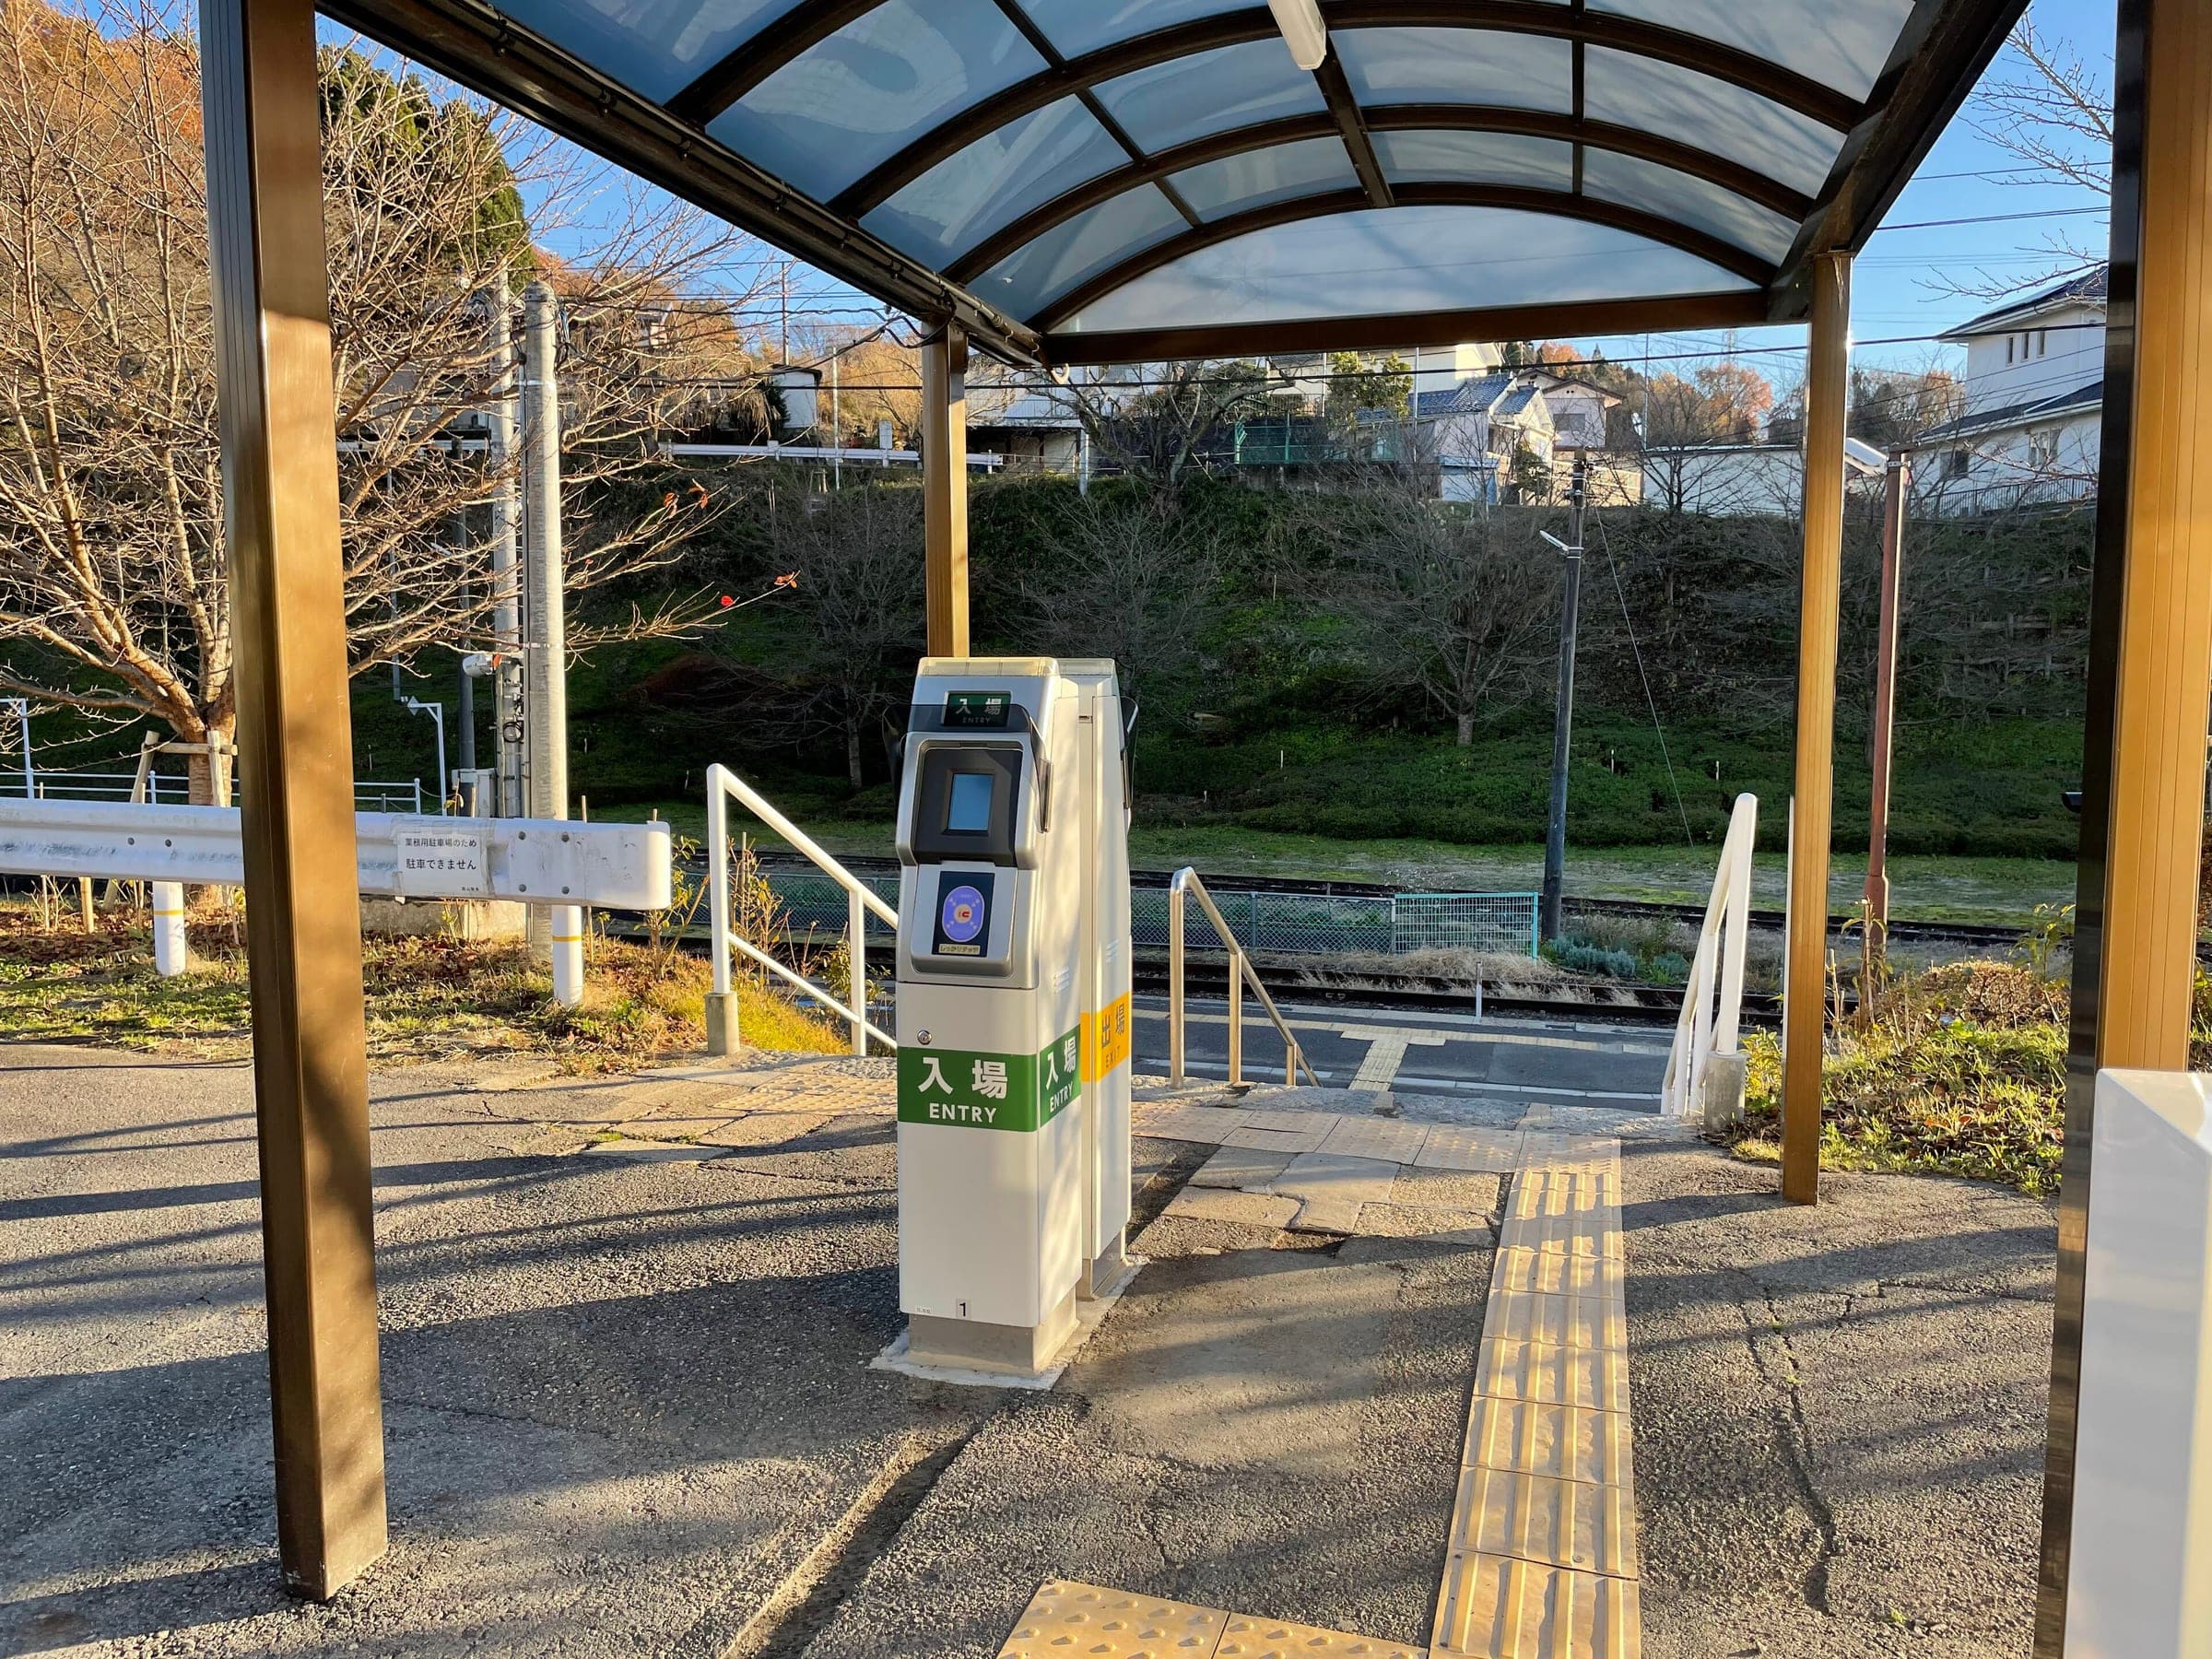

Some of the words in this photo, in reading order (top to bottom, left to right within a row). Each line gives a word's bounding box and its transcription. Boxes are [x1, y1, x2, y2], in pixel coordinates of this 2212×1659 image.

[955, 697, 1003, 715] 入場
[406, 857, 477, 870] 駐車できません
[1045, 1036, 1077, 1090] 入場
[1105, 1045, 1121, 1068] EXIT
[917, 1056, 1008, 1100] 入場
[1050, 1081, 1074, 1113] ENTRY
[929, 1102, 997, 1124] ENTRY
[959, 1301, 967, 1317] 1
